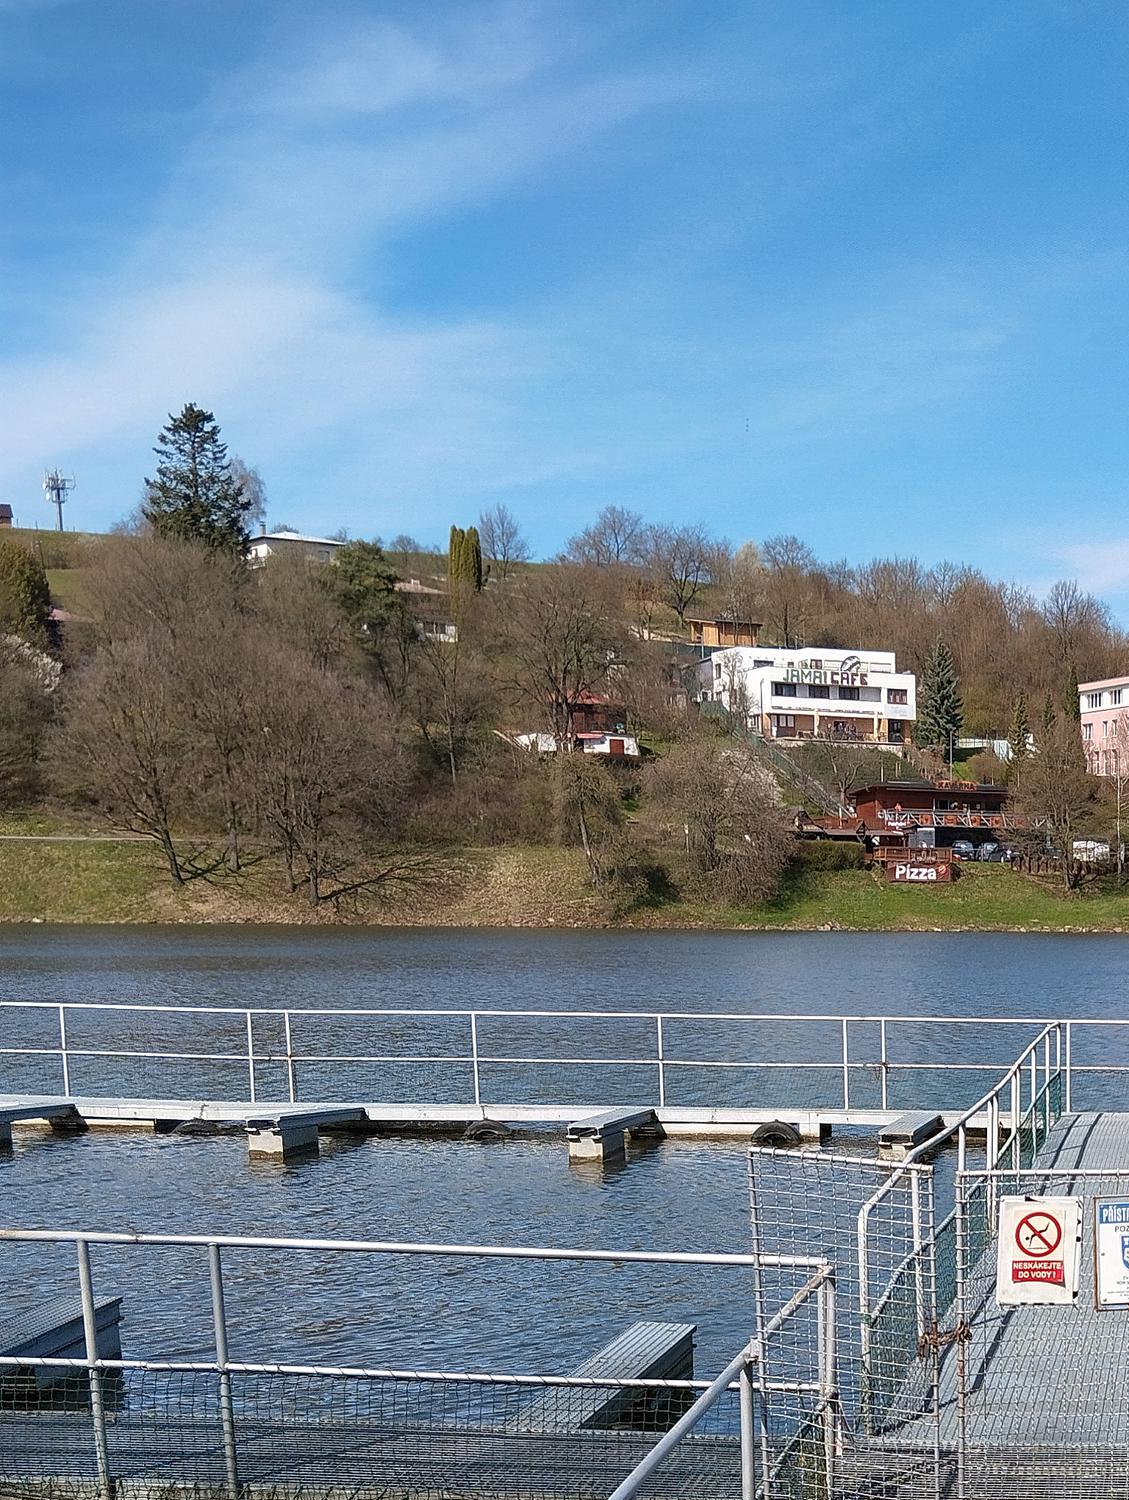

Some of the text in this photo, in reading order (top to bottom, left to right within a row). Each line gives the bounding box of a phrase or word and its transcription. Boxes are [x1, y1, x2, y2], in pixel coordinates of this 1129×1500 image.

[783, 669, 827, 684] JAMAI
[895, 864, 937, 880] Pizza
[1013, 1260, 1063, 1270] NESKÁKEJTE
